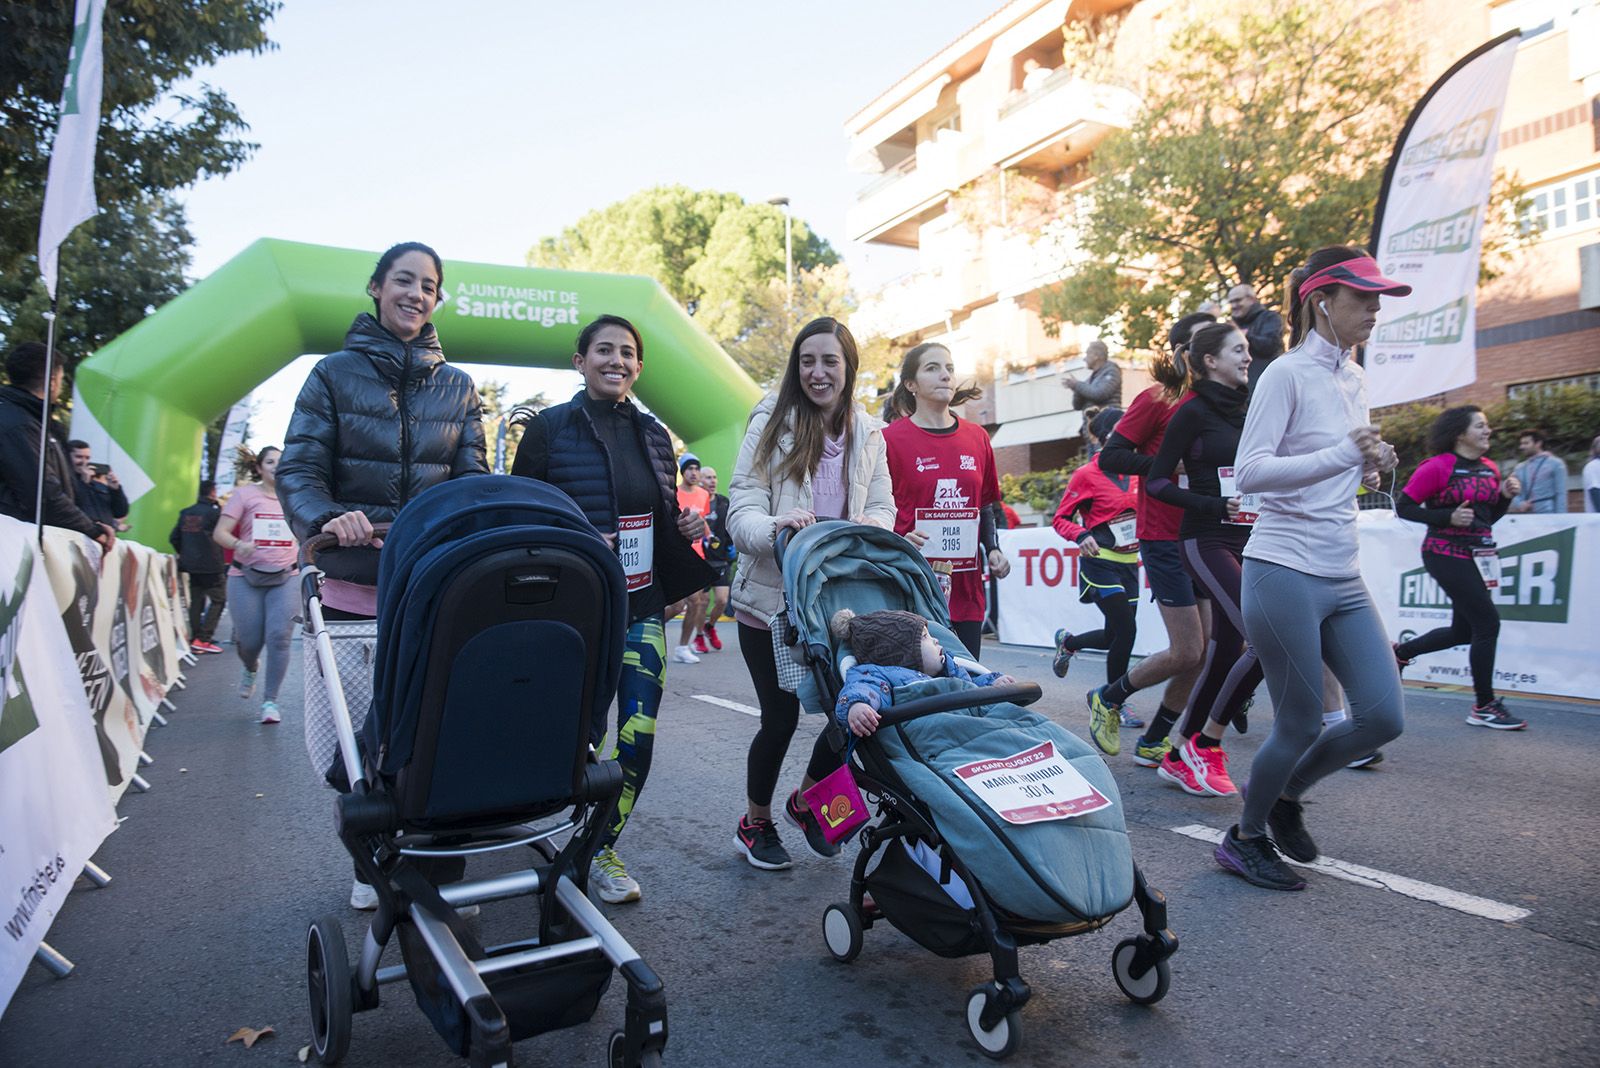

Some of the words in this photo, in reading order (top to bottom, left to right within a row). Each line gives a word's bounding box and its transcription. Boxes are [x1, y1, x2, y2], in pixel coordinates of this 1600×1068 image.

[1389, 214, 1473, 252] FINISHER
[456, 283, 556, 302] AJUNTAMENT
[559, 291, 578, 305] DE
[456, 296, 579, 328] SantCugat
[1379, 307, 1461, 343] FINISHER
[940, 488, 962, 498] 21K
[942, 526, 961, 536] PILAR
[942, 538, 961, 551] 3195
[982, 761, 1005, 771] SANT
[1004, 755, 1034, 768] CUGAT
[1033, 751, 1046, 761] 22
[982, 773, 1019, 789] MARÍA
[1017, 764, 1064, 783] TRINIDAD
[1019, 783, 1055, 799] 3014
